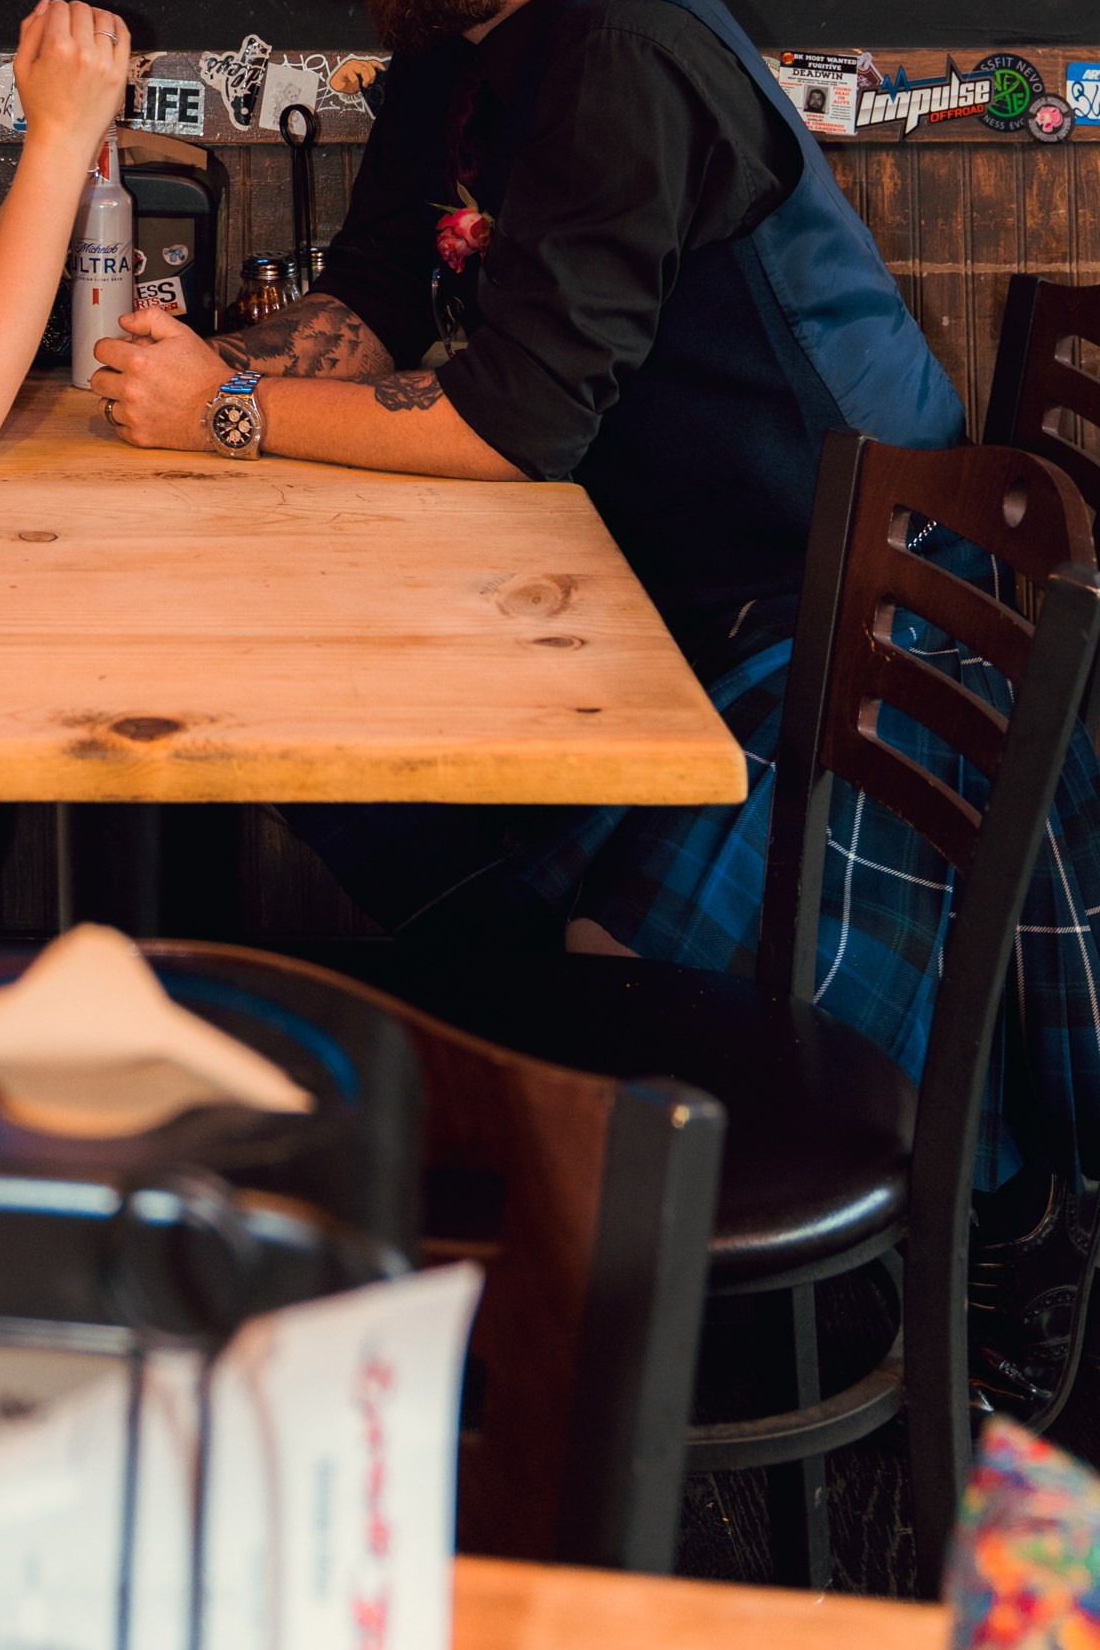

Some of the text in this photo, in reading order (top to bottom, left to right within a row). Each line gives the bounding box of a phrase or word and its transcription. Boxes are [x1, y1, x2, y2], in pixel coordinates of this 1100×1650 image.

[805, 54, 825, 62] MOST
[826, 56, 857, 65] WANTED
[808, 62, 842, 71] FUGITIVE
[980, 57, 1015, 71] SSFIT
[792, 68, 844, 80] DEADWIN
[124, 84, 201, 124] LIFE
[856, 69, 990, 134] Impulse
[930, 105, 985, 123] OFFROAD
[983, 114, 1006, 130] NESS
[75, 240, 122, 254] Michelob
[136, 281, 176, 303] ESS
[135, 297, 160, 309] RTS
